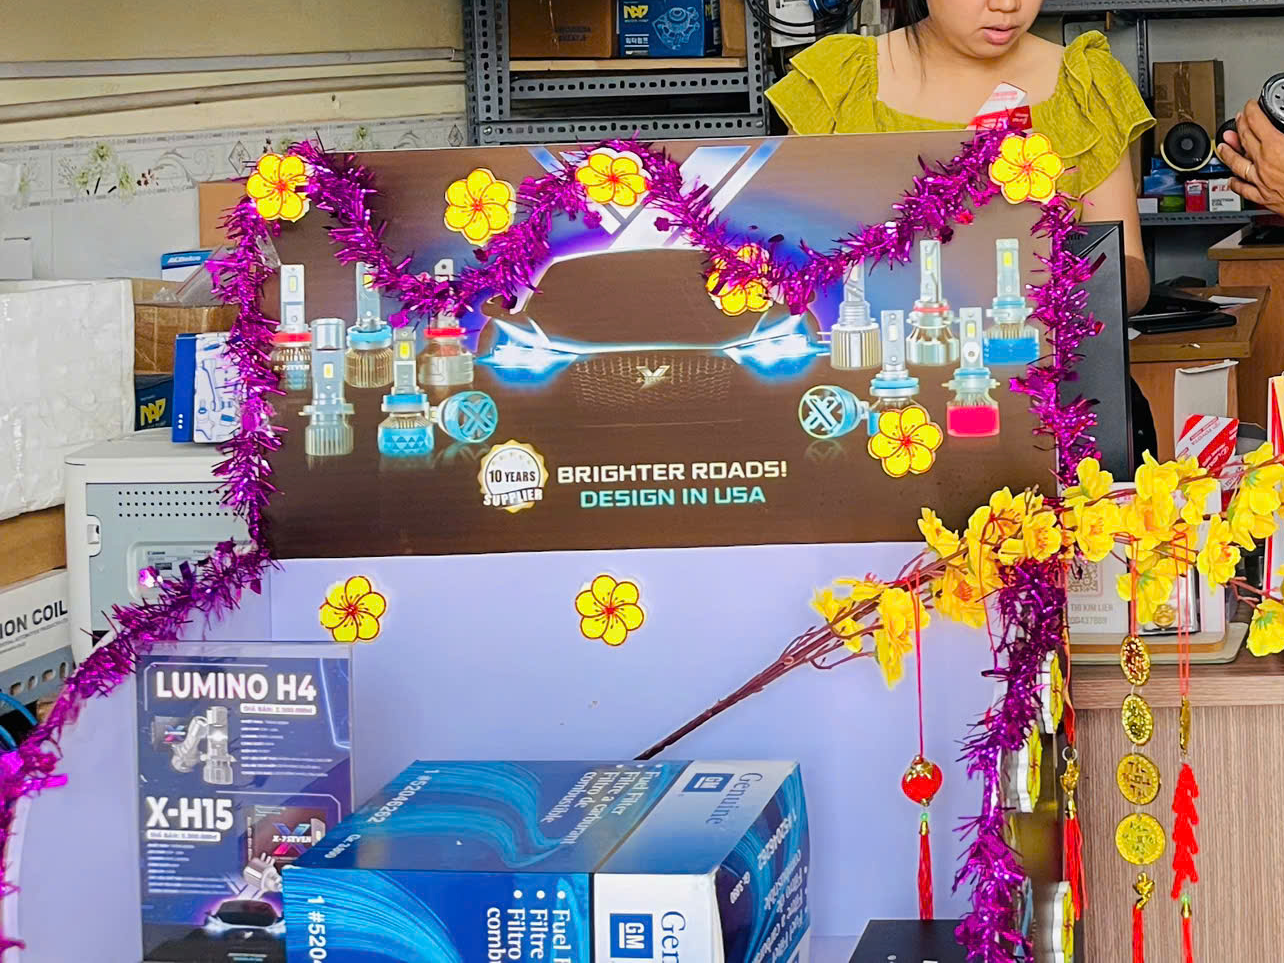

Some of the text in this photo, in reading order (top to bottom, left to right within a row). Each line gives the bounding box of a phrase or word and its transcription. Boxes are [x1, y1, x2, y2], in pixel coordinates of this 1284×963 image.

[488, 469, 536, 484] 10 YEARS
[557, 460, 788, 484] BRIGHTER ROADS!
[482, 487, 544, 507] SUPPLIER
[580, 486, 766, 508] DESIGN IN USA
[32, 600, 68, 625] COIL
[156, 671, 317, 702] LUMINO H4
[613, 771, 641, 795] Filtre
[146, 796, 234, 830] X-H15
[705, 772, 763, 825] Genuine
[308, 910, 328, 963] #520
[506, 907, 526, 961] Filtro
[529, 907, 548, 960] Filtre
[551, 908, 571, 950] Fuel
[625, 921, 646, 950] GM
